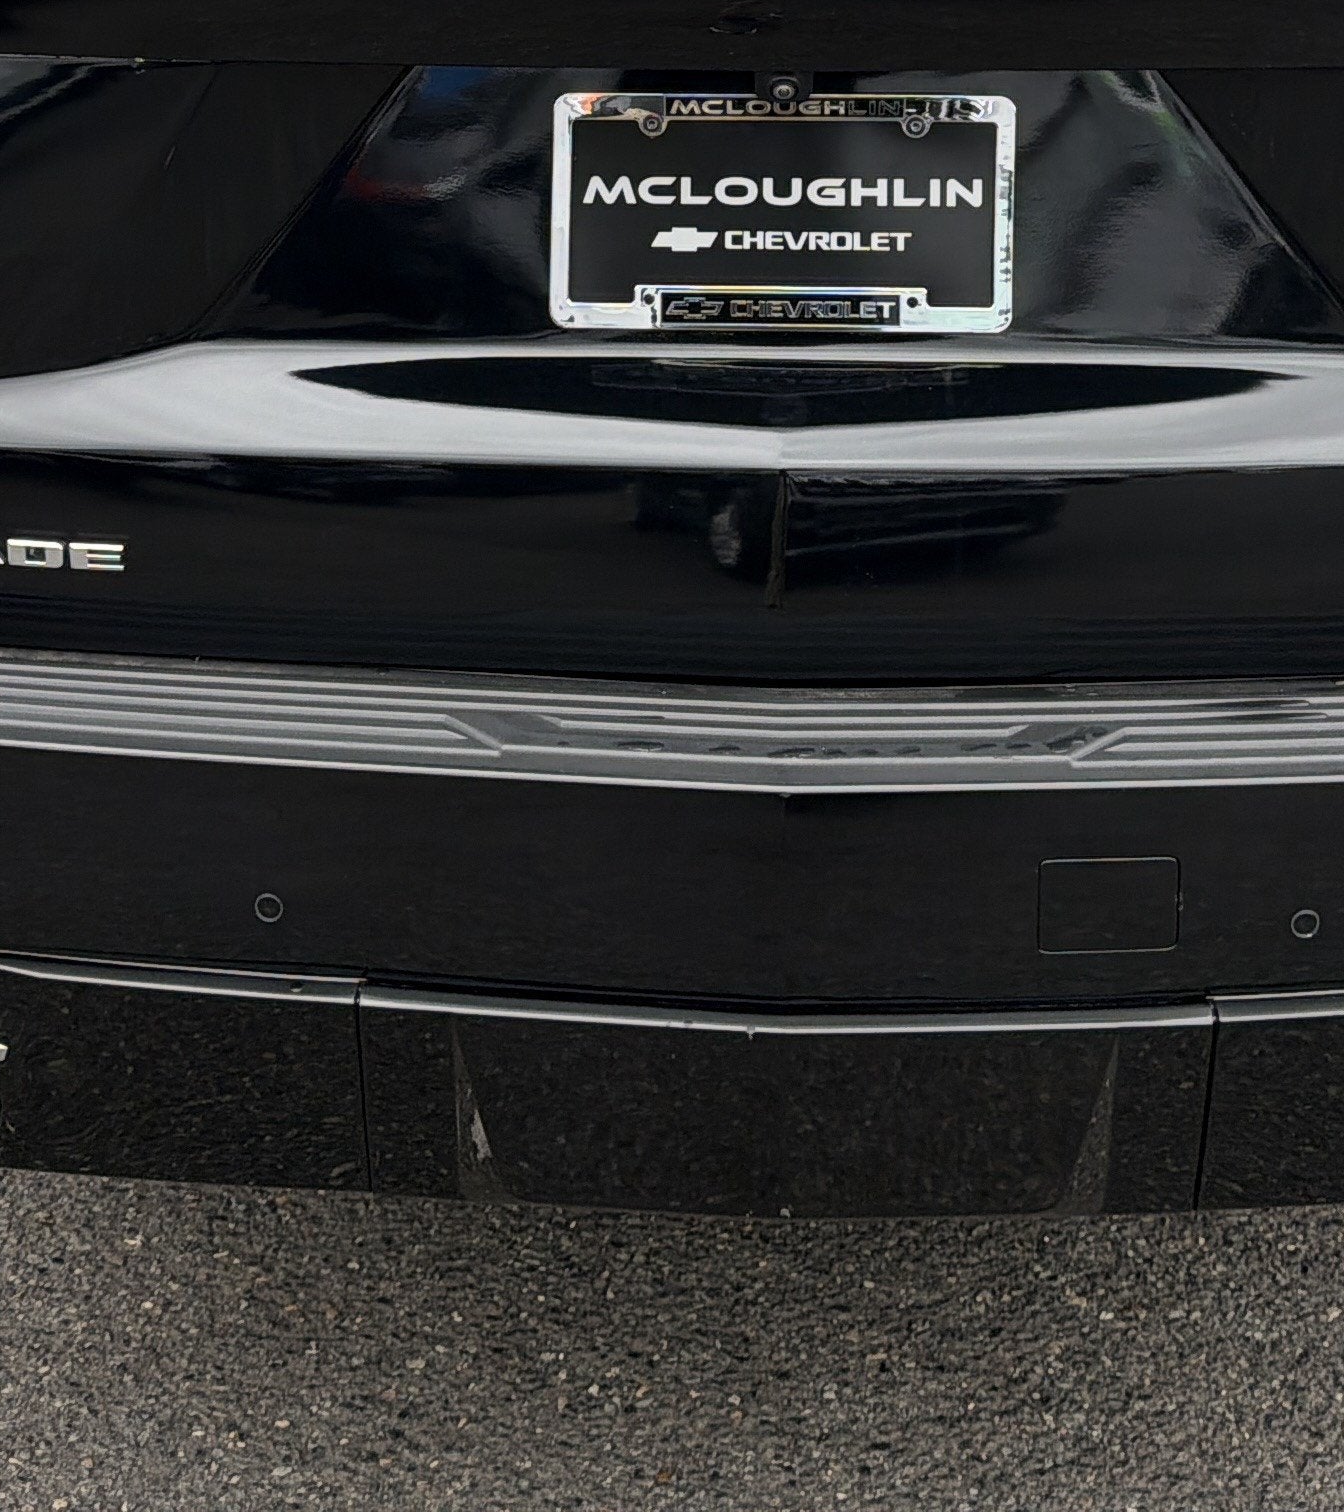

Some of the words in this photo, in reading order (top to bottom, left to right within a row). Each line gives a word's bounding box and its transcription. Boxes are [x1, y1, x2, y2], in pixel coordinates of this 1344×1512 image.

[670, 98, 903, 117] MCLOUGHLIN
[582, 175, 984, 208] MCLOUGHLIN
[724, 230, 913, 252] CHEVROLET
[730, 299, 896, 320] CHEVROLET
